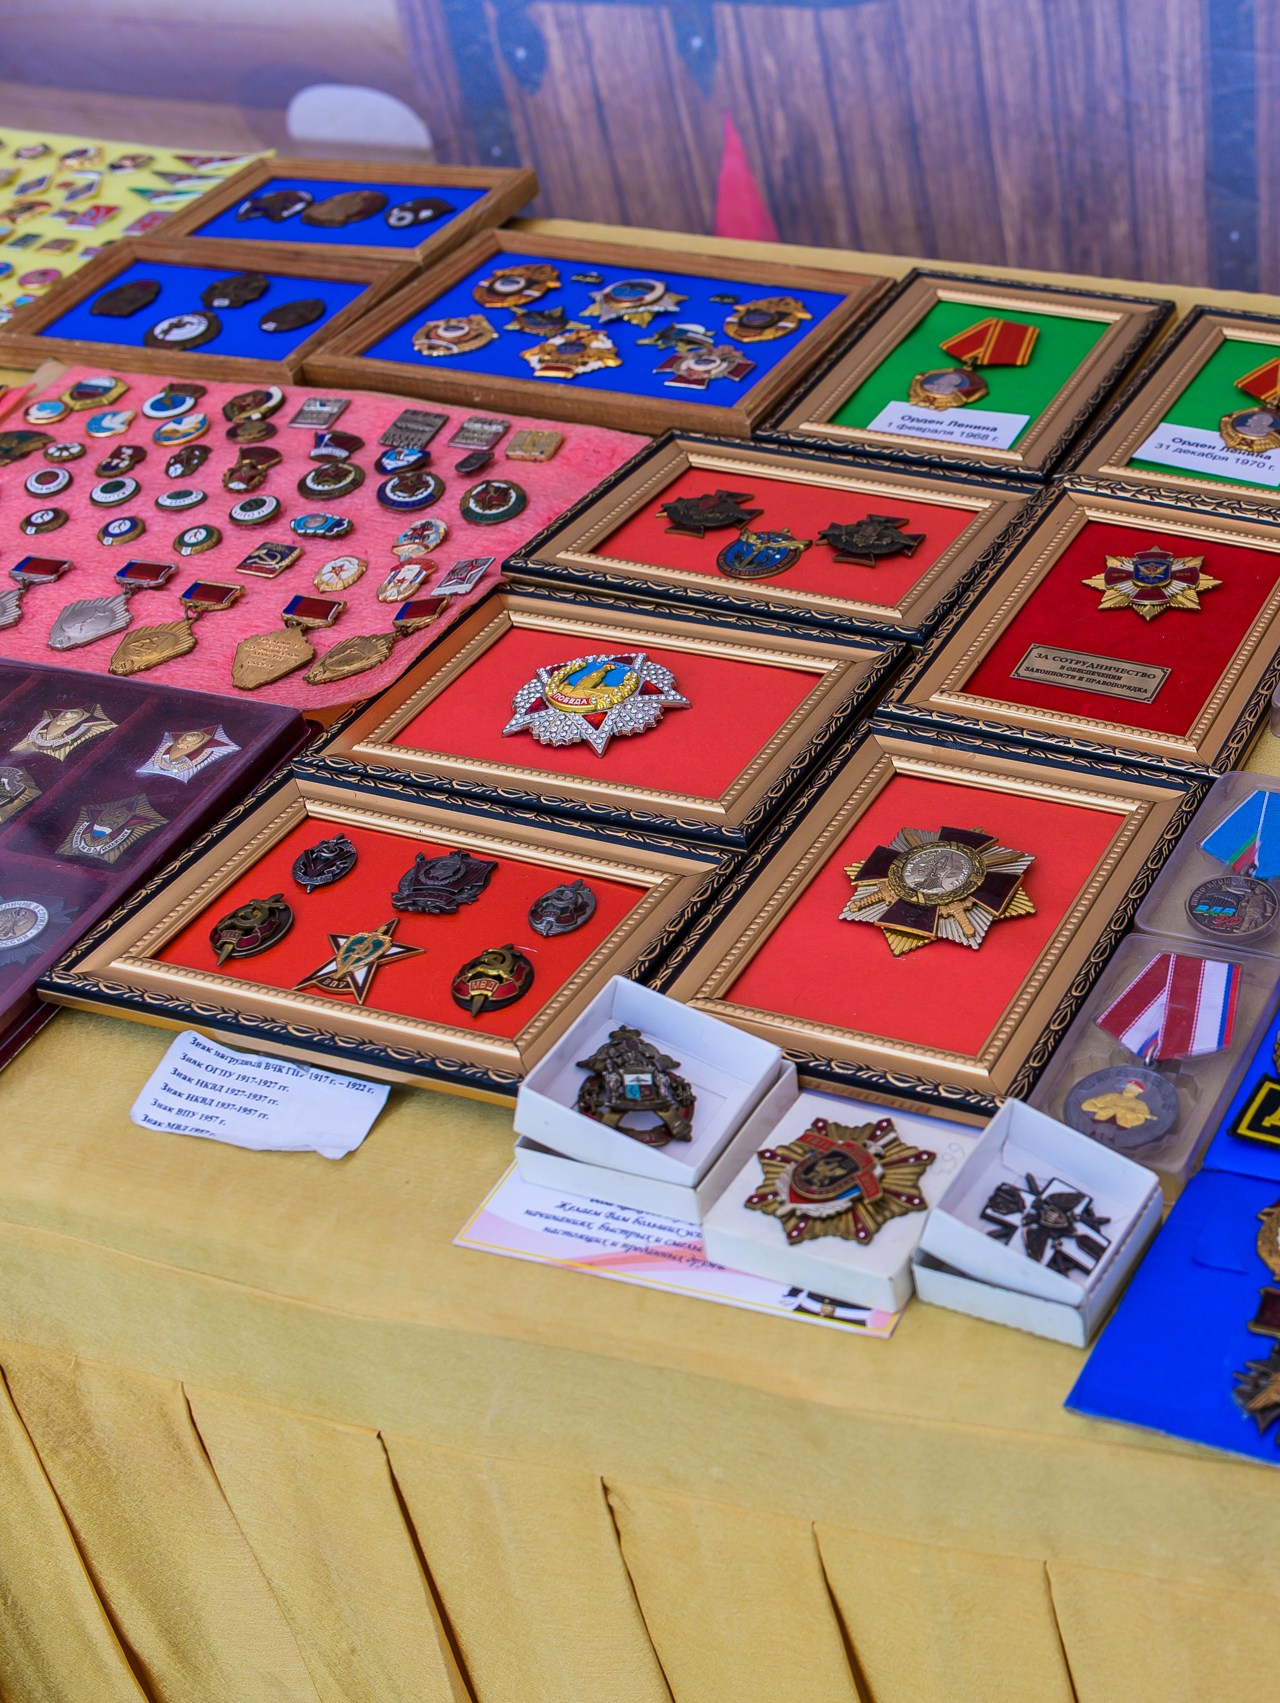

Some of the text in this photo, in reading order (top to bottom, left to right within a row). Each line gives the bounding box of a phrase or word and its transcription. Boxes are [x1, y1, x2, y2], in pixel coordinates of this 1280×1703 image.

[896, 424, 954, 437] февраля
[960, 431, 990, 441] 1968
[901, 414, 998, 433] Орден Ленина
[1171, 437, 1216, 450] Орден
[1154, 442, 1169, 450] 31
[1172, 447, 1229, 461] декабря
[1235, 457, 1266, 469] 1970
[1034, 652, 1157, 680] ЗА СОТРУДНИЧЕСТВО
[1066, 666, 1123, 681] ОБЕСПЕЧЕНИИ
[1024, 666, 1077, 681] ЗАКОННОСТИ
[1085, 676, 1148, 694] ПРАВОПОРЯДКА
[552, 692, 589, 706] ПОБЕДА
[1212, 915, 1242, 926] 90
[471, 980, 495, 991] МВД
[179, 1052, 203, 1069] Знак
[205, 1064, 235, 1080] ОГПУ
[235, 1073, 279, 1090] 1917-1927
[190, 1036, 212, 1054] Знак
[263, 1061, 285, 1074] ВЧК
[309, 1072, 330, 1084] 1917
[346, 1080, 366, 1093] 1922
[170, 1067, 194, 1084] Знак
[195, 1078, 225, 1093] НКВД
[225, 1086, 269, 1105] 1927-1937
[150, 1098, 175, 1114] Знак
[175, 1106, 198, 1119] ВПУ
[199, 1113, 219, 1124] 1957
[160, 1082, 184, 1098] Знак
[185, 1092, 215, 1107] НКВД
[215, 1100, 259, 1118] 1937-1957
[141, 1114, 164, 1129] Знак
